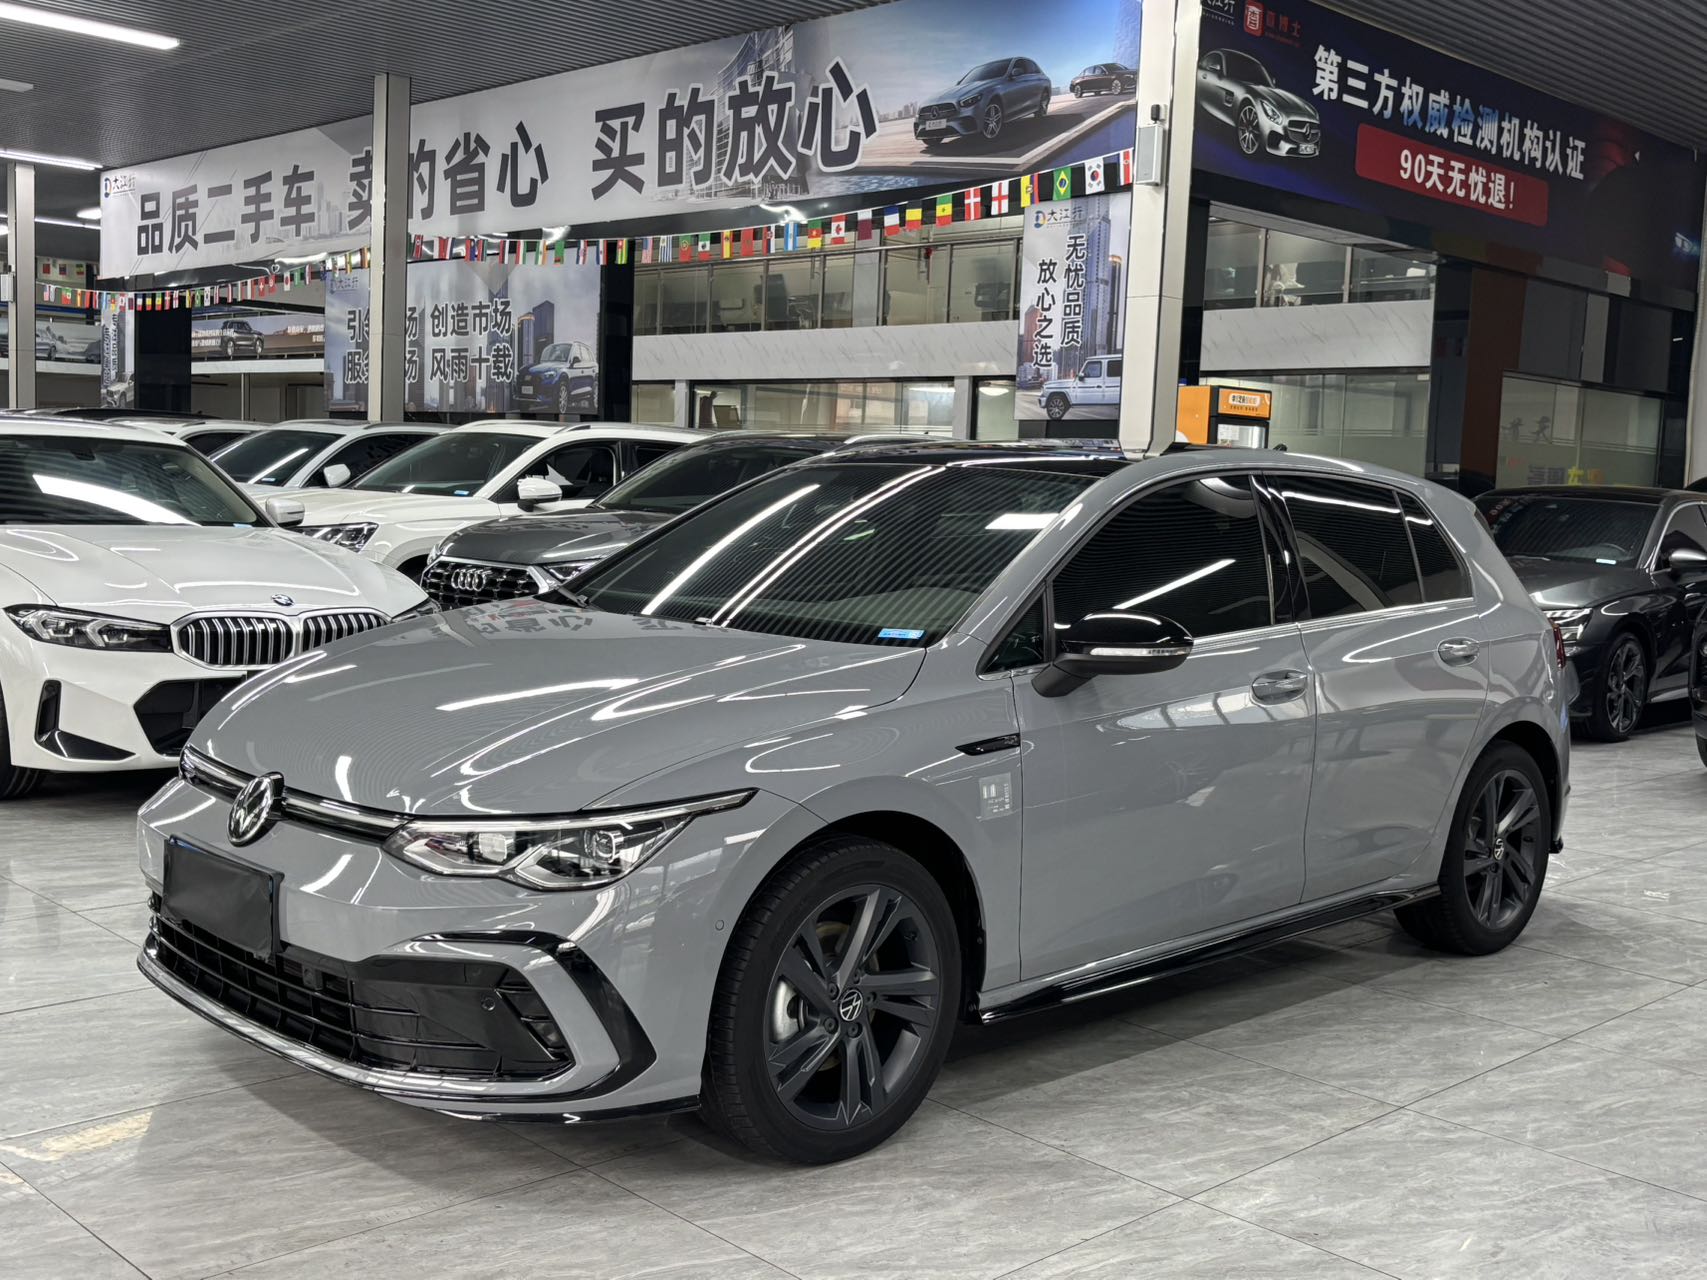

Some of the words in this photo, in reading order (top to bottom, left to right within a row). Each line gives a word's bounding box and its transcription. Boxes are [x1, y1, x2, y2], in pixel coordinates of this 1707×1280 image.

[591, 58, 877, 200] 买的放心
[1312, 45, 1586, 180] 第三方权威检测机构认证
[137, 164, 316, 256] 品质二手车
[1400, 149, 1515, 210] 90天无忧退!
[430, 300, 512, 339] 创造市场
[1032, 257, 1059, 369] 放心之选
[1060, 234, 1087, 347] 无忧品质
[430, 342, 513, 383] 风雨十载
